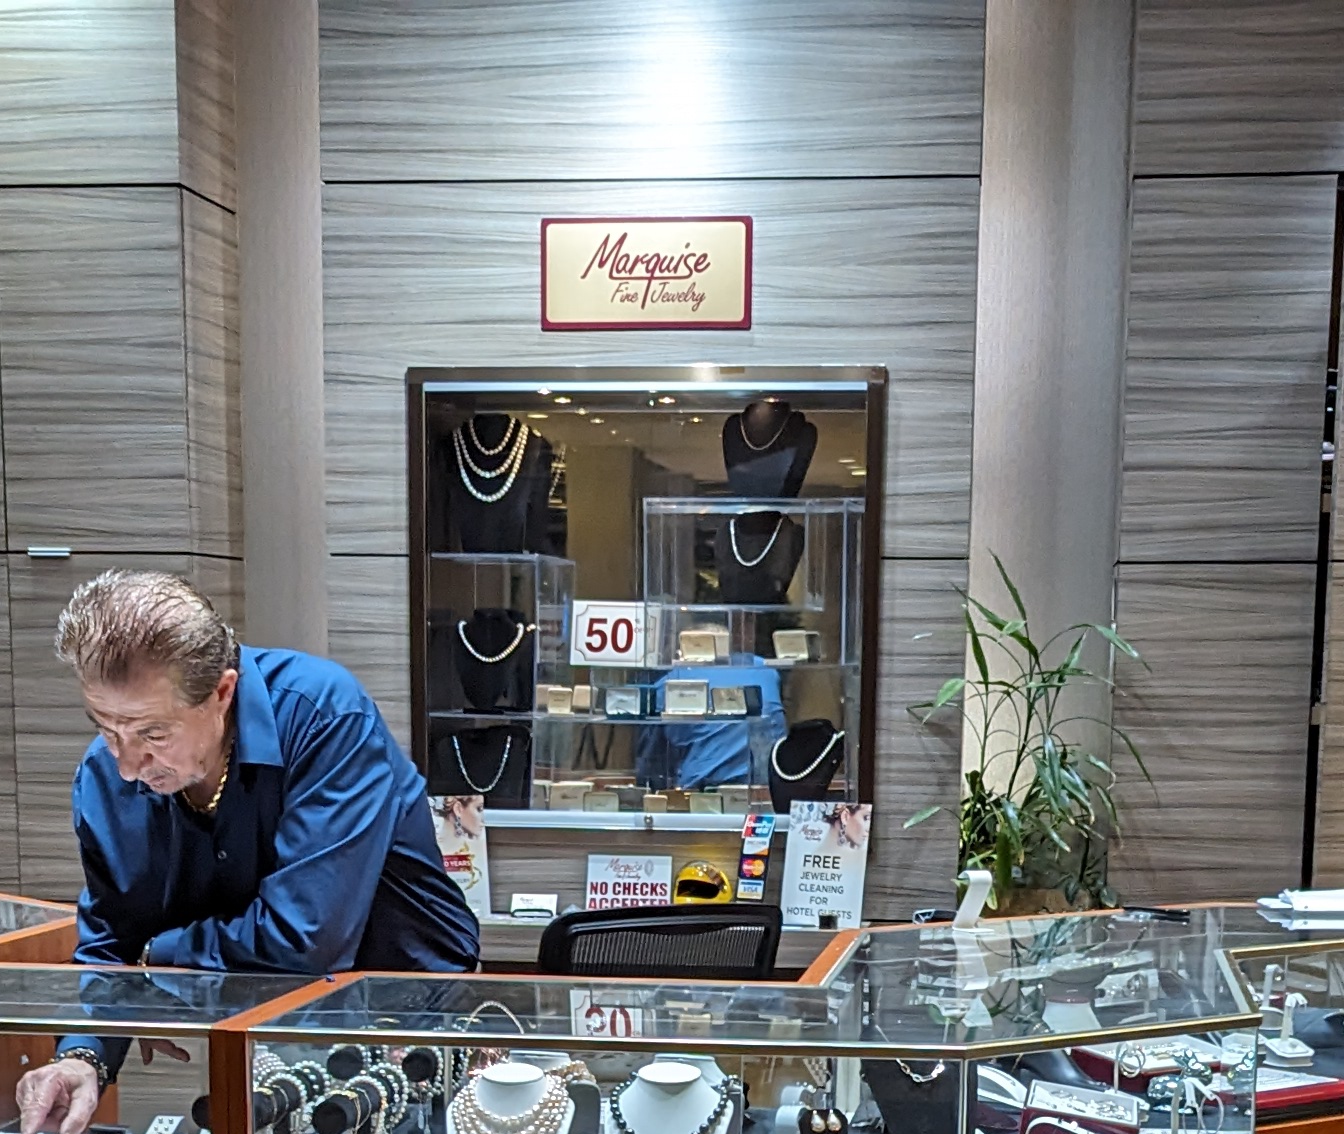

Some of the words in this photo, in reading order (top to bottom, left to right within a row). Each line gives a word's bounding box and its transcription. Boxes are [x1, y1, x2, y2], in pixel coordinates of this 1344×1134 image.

[580, 231, 711, 310] Marquise
[611, 281, 639, 304] Fine
[650, 281, 706, 312] Jewelry
[584, 617, 634, 654] 50
[803, 854, 841, 869] FREE
[800, 871, 843, 882] JEWELRY
[590, 881, 608, 896] NO
[612, 881, 668, 897] CHECKS
[798, 883, 844, 895] CLEANING
[809, 896, 828, 905] FOR
[786, 906, 814, 917] HOTEL
